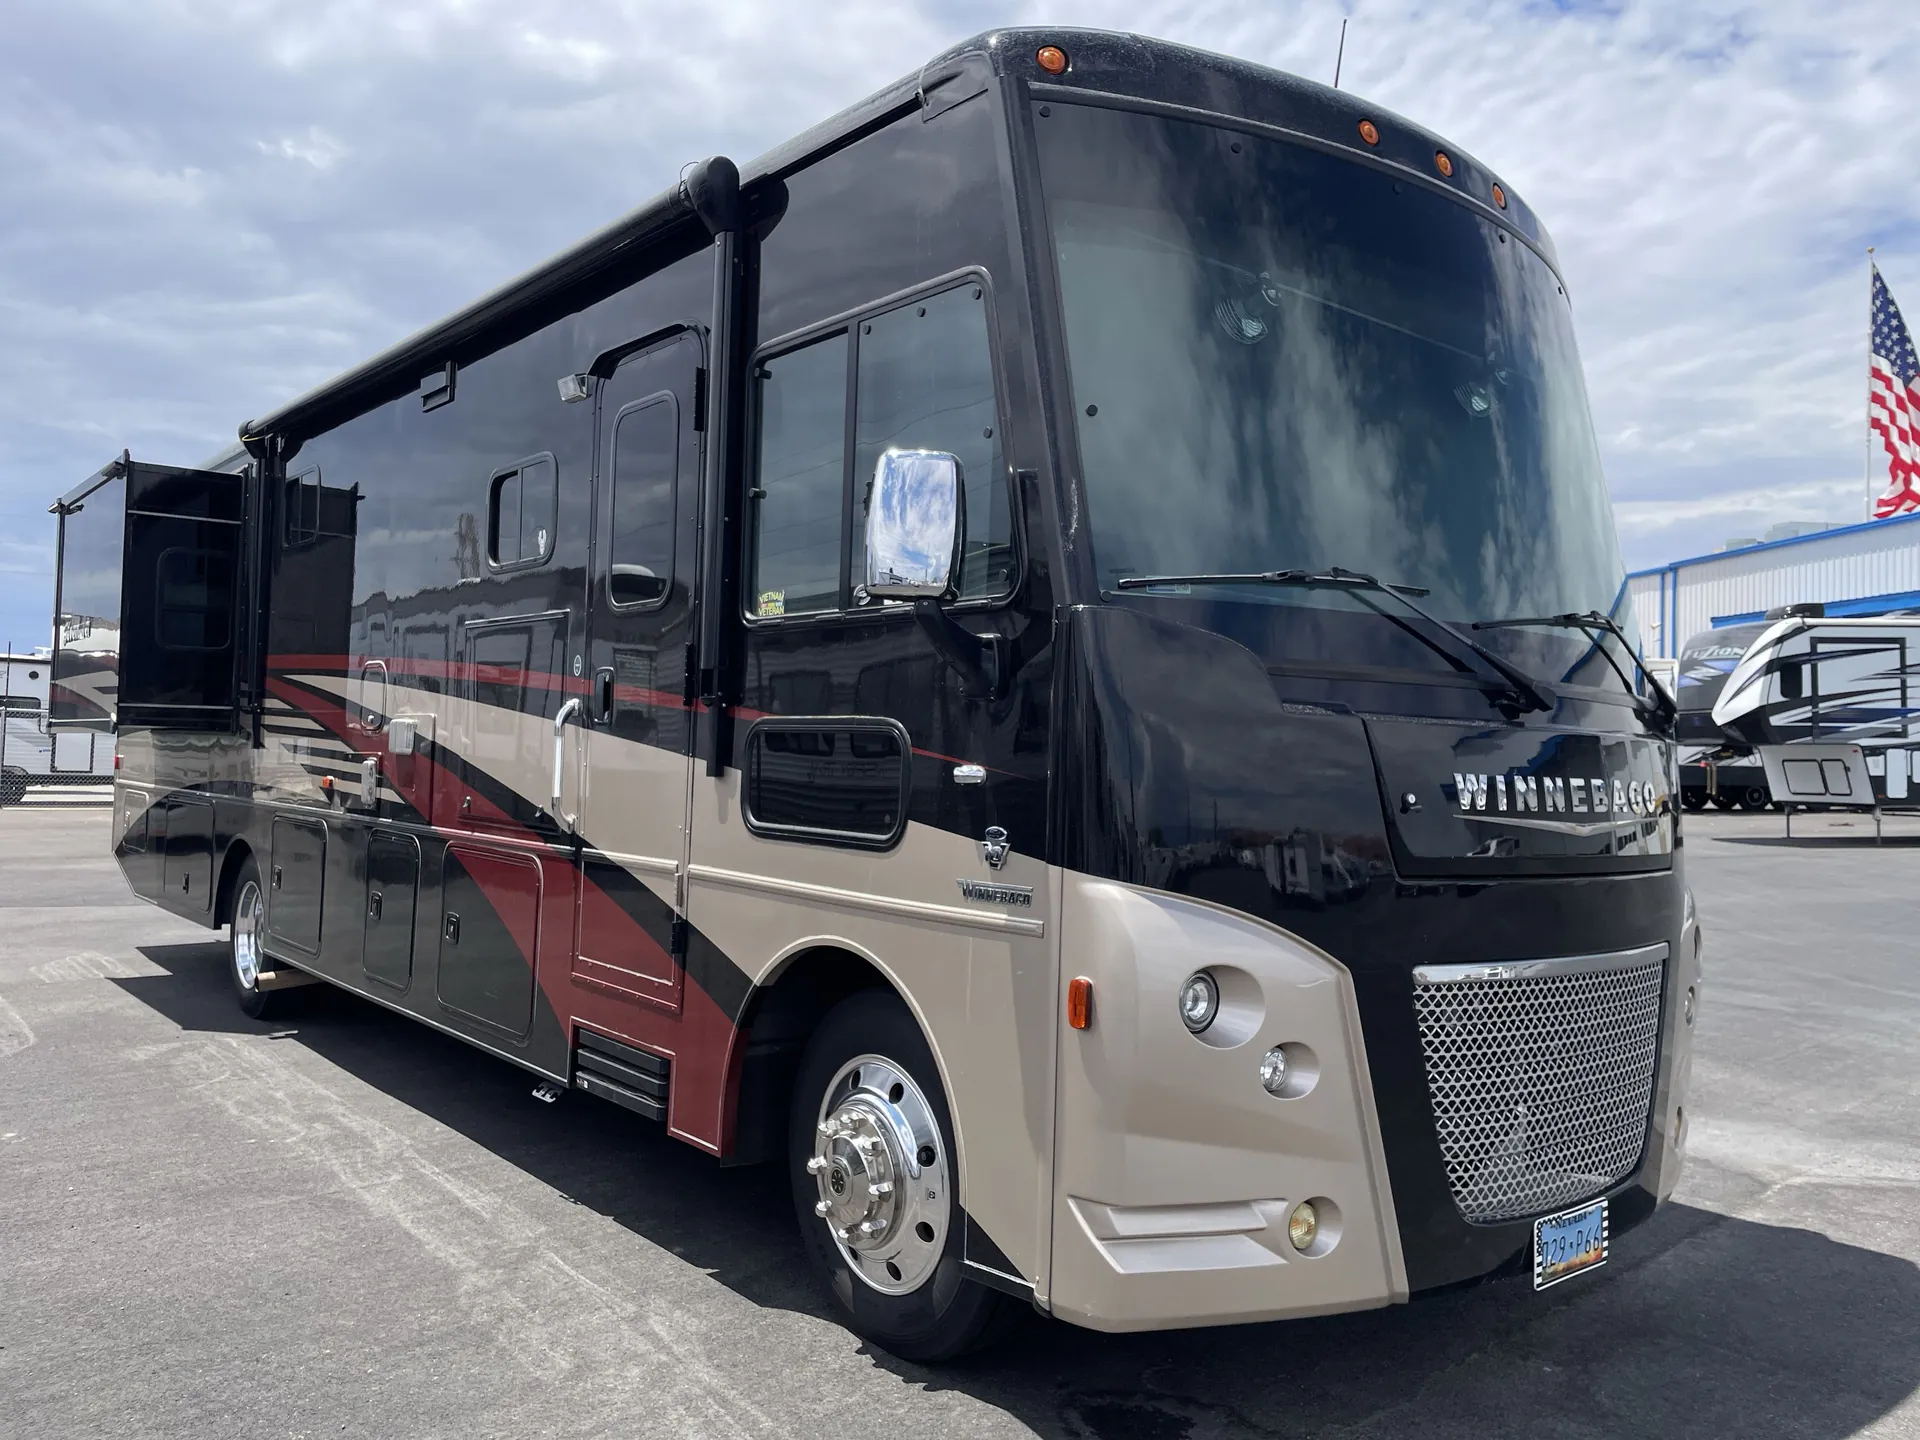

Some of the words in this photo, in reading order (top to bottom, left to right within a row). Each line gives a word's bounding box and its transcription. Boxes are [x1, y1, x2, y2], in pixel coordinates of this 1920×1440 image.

[759, 590, 785, 603] VIETNAM
[758, 605, 785, 616] VETERAN
[1452, 772, 1656, 814] WINNEBAGO
